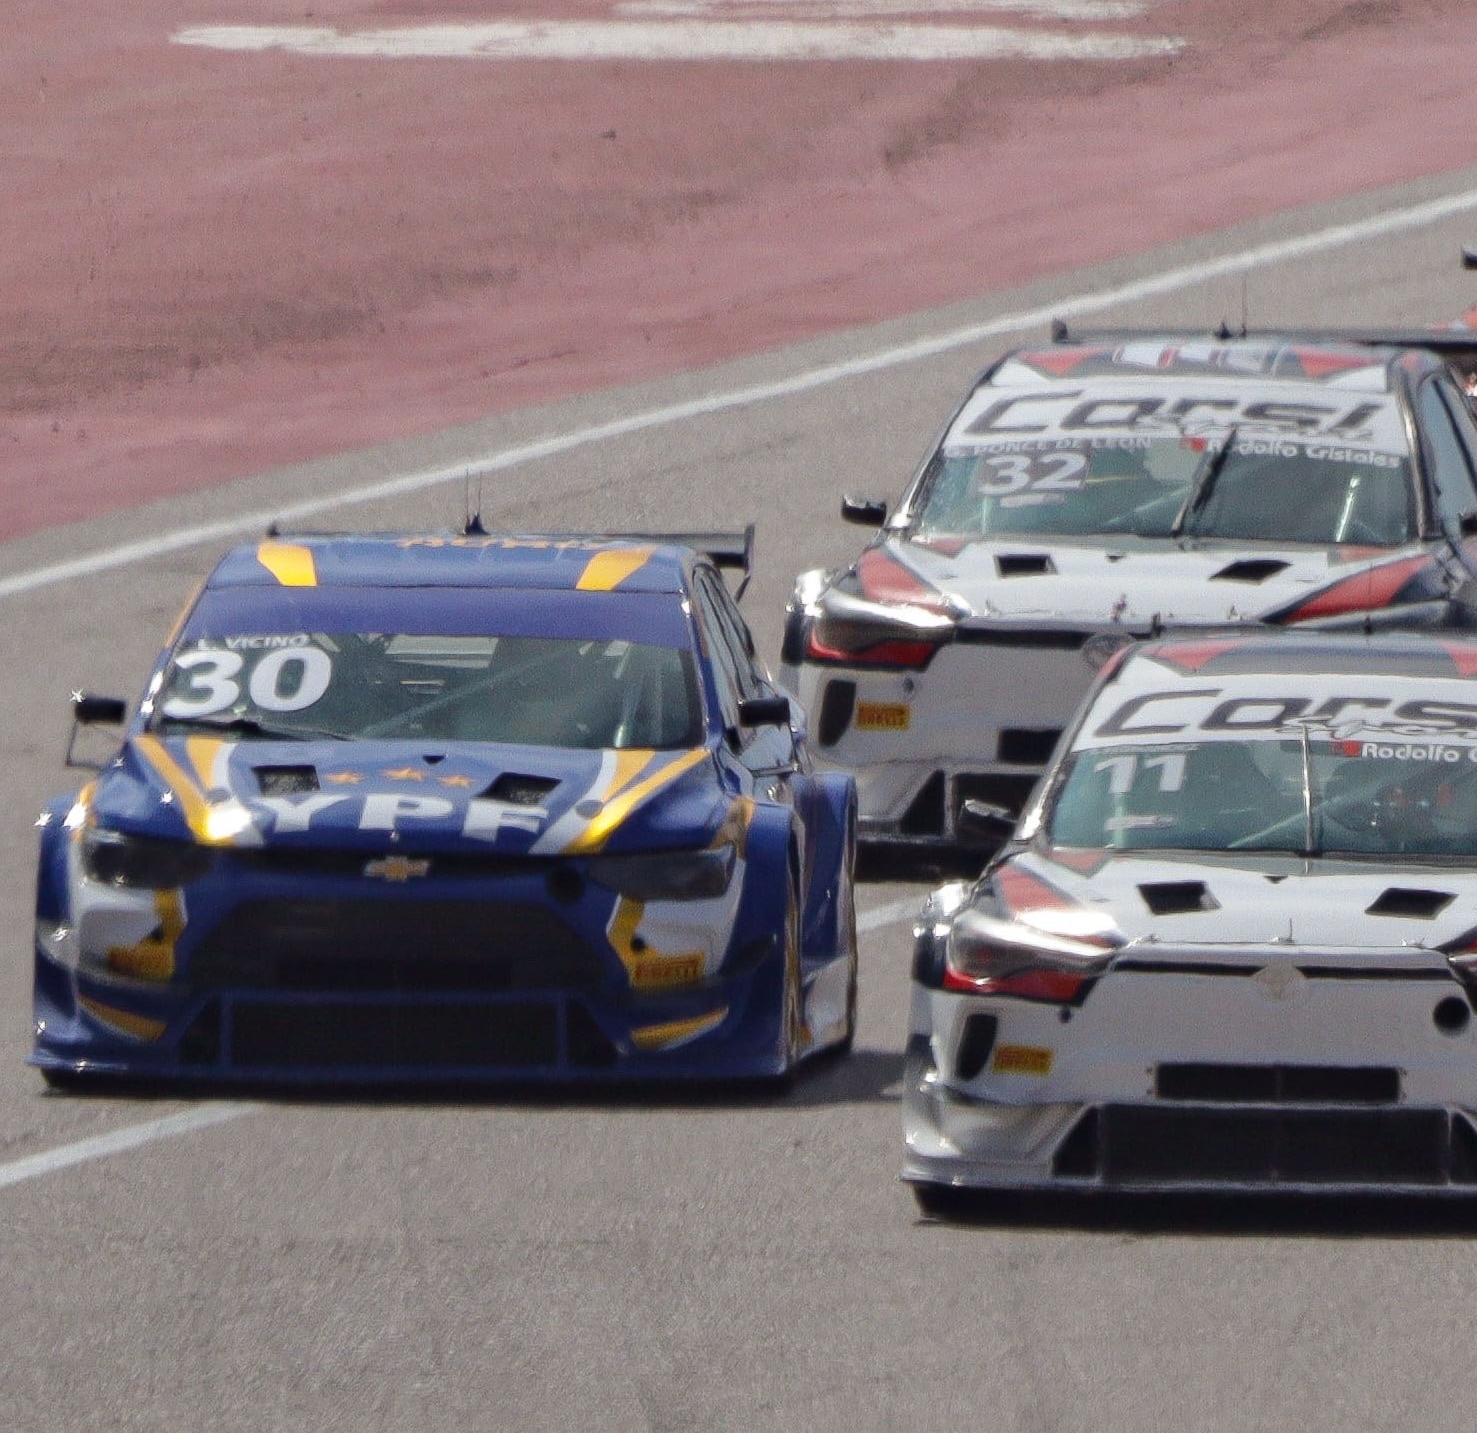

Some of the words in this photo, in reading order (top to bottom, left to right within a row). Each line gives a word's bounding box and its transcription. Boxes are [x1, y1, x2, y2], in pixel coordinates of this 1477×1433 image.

[963, 389, 1386, 435] Corsi
[976, 452, 1090, 495] 32
[1305, 443, 1400, 468] Cristales
[161, 647, 332, 717] 30
[1093, 753, 1188, 793] 11
[1361, 741, 1460, 763] Rodolfo
[251, 792, 550, 843] YPF
